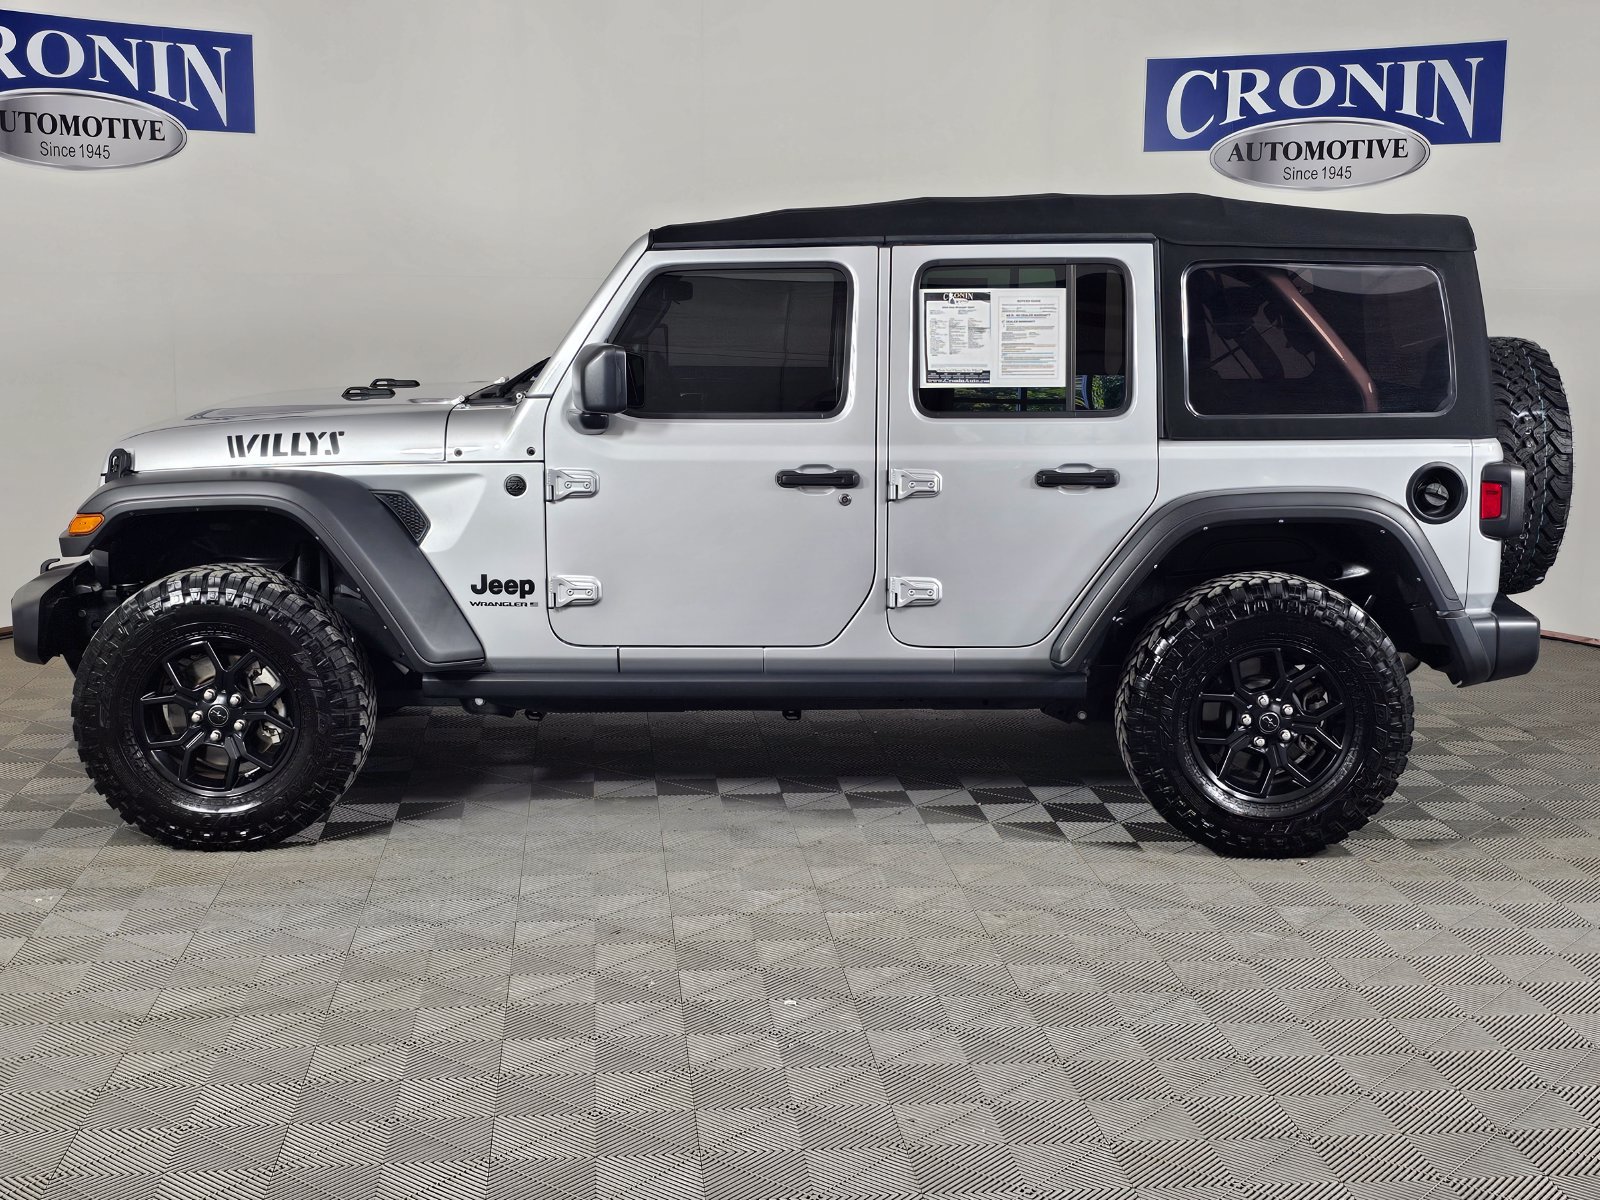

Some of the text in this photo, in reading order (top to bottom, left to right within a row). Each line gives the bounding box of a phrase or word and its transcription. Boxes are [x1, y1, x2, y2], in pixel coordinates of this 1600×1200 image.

[1166, 57, 1484, 139] CRONIN
[39, 141, 111, 160] Since 1945
[1226, 137, 1409, 163] AUTOMOTIVE
[1282, 165, 1352, 181] Since 1945
[226, 430, 345, 459] WILLYS
[470, 573, 536, 599] Jeep
